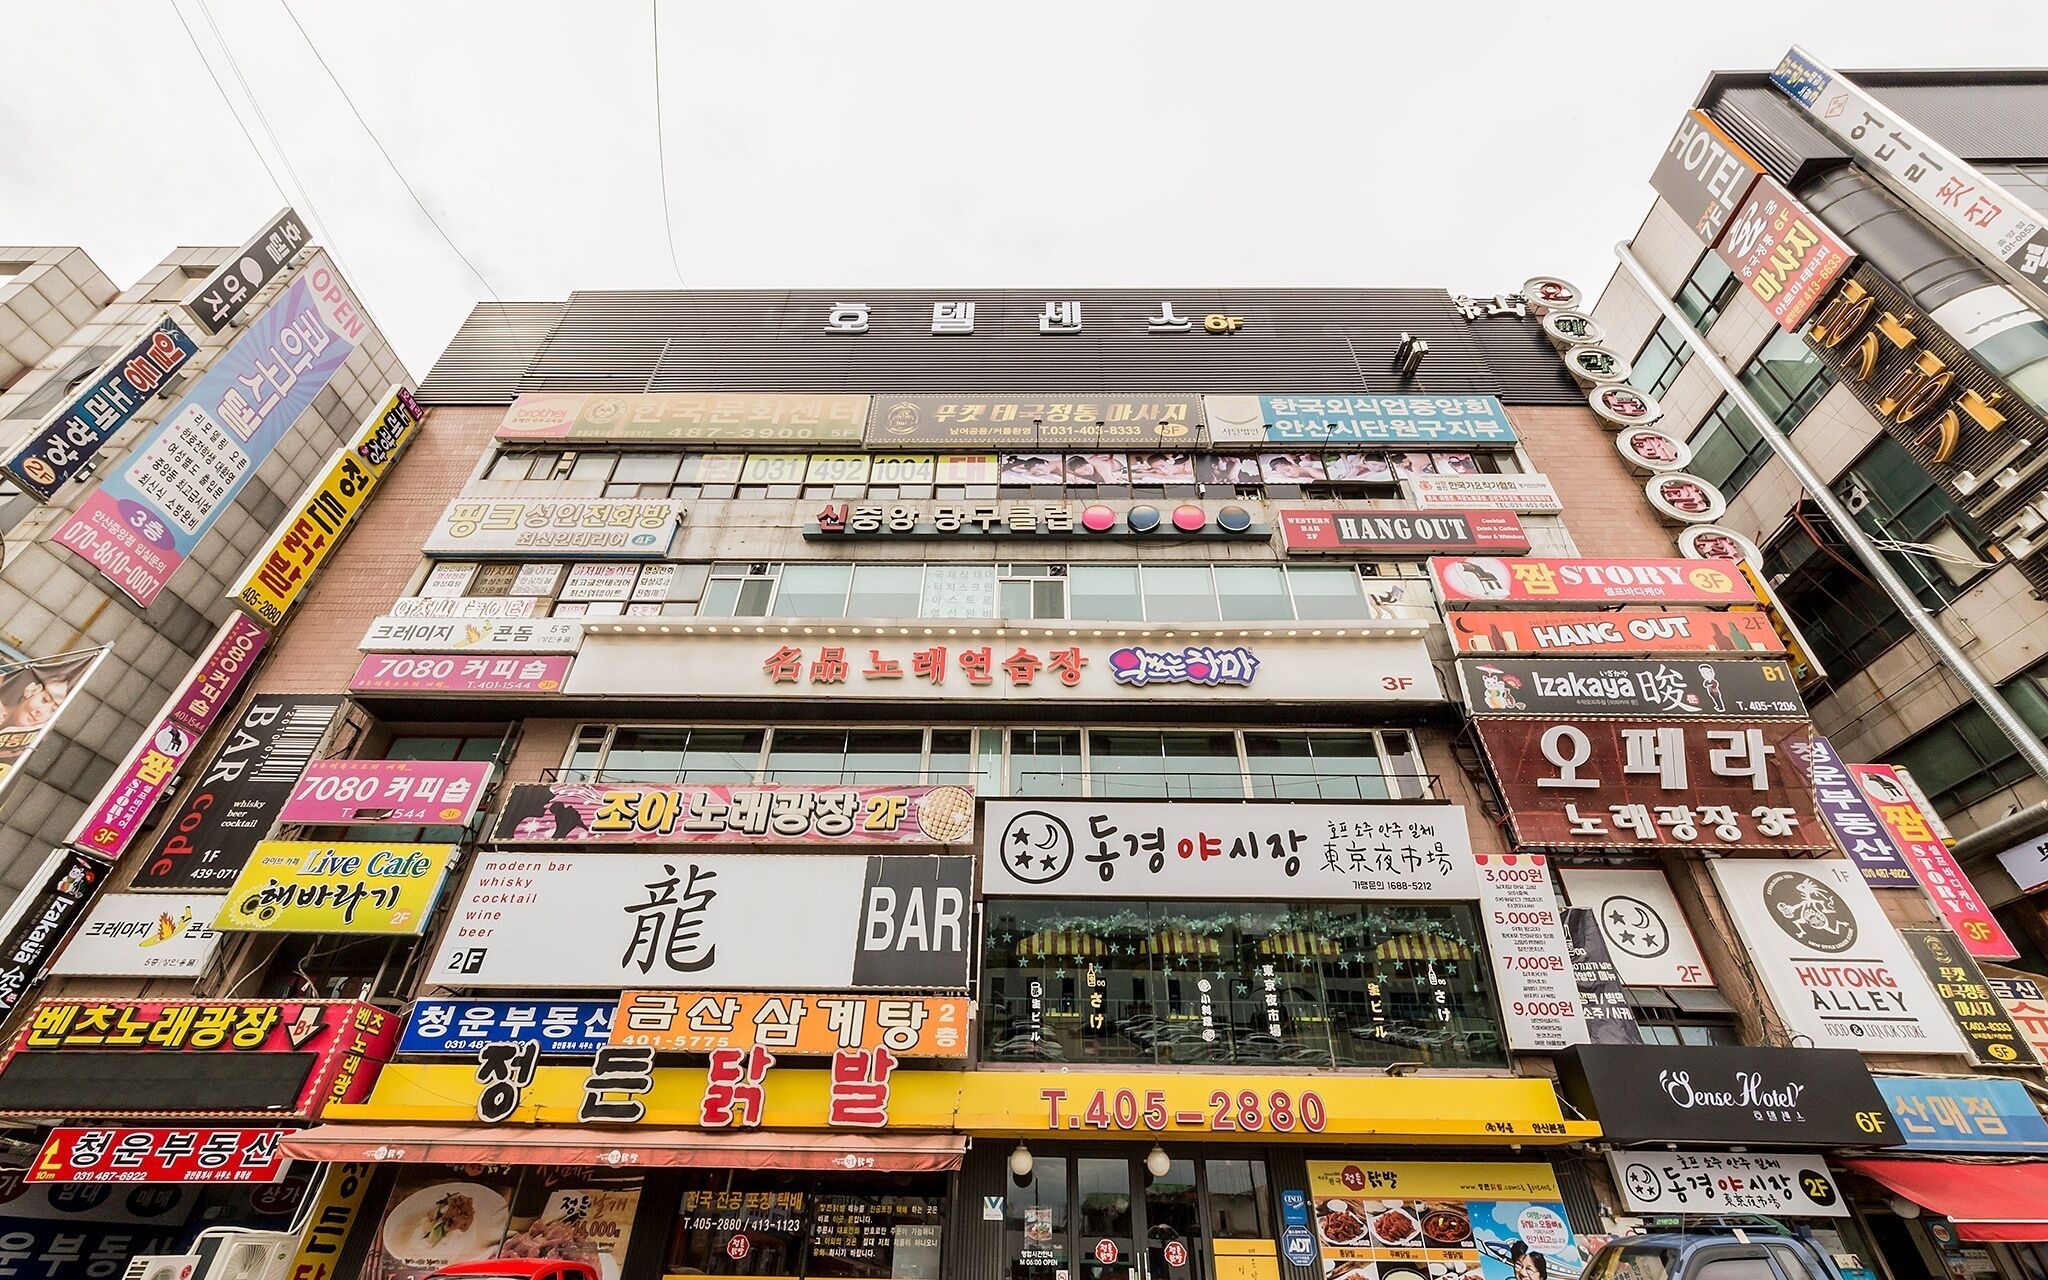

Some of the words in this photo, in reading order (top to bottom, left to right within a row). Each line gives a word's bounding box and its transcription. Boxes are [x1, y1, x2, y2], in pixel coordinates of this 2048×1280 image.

[1670, 116, 1745, 210] HOTEL
[1701, 205, 1723, 240] 7F
[1774, 207, 1790, 232] 6F
[266, 219, 302, 266] 호텔
[2001, 222, 2036, 256] 401-0053
[1752, 224, 1822, 303] 마사지
[1802, 253, 1842, 303] 413-6633
[203, 273, 250, 322] 야자
[311, 268, 366, 339] OPEN
[1774, 279, 1804, 316] 아로마
[1204, 313, 1244, 335] 6F
[517, 407, 569, 418] brother
[632, 400, 861, 426] 한국문화센터
[933, 403, 987, 423] 푸켓
[989, 403, 1100, 423] 태국정통
[1105, 402, 1188, 422] 마사지
[1270, 396, 1494, 418] 한국외식업중앙회
[193, 413, 229, 450] 리모델링
[228, 449, 248, 471] 오픈
[366, 402, 410, 464] 노래광장
[666, 426, 814, 440] 487-3900
[23, 456, 57, 486] 2F
[151, 456, 178, 482] 중앙동
[752, 457, 798, 482] 031
[813, 457, 863, 481] 492
[875, 458, 932, 481] 1004
[136, 471, 167, 502] 최신식
[199, 472, 226, 501] 출입문
[128, 508, 166, 542] 3층
[448, 502, 525, 538] 핑크
[523, 504, 672, 529] 성인전화방
[1286, 517, 1331, 526] WESTERN
[1300, 525, 1321, 533] BAR
[1340, 516, 1414, 539] HANG
[1412, 517, 1469, 540] OUT
[515, 531, 628, 547] 최신인테리어
[634, 534, 655, 546] 4F
[61, 519, 160, 600] 070-8610-0007
[1511, 563, 1557, 596] 짬
[1559, 564, 1687, 588] STORY
[1696, 571, 1726, 590] 3F
[1603, 585, 1666, 597] 셀프바디케어
[242, 586, 282, 624] 405-2880
[371, 624, 456, 642] 크레이지
[492, 624, 534, 642] 콘돔
[1532, 621, 1625, 648] HANG
[1627, 616, 1691, 641] OUT
[1742, 616, 1766, 630] 2F
[220, 623, 261, 673] 7080
[374, 659, 453, 679] 7080
[460, 660, 548, 680] 커피숍
[763, 645, 850, 684] 名品
[862, 645, 1089, 688] 노래연습장
[188, 670, 230, 718] 커피숍
[467, 680, 532, 691] T.401-1544
[1381, 676, 1414, 691] 3F
[1535, 671, 1637, 700] Izakaya
[1762, 666, 1787, 682] B1
[1749, 701, 1798, 713] 405-1206
[174, 708, 206, 733] 401-1544
[203, 704, 284, 789] BAR
[1537, 724, 1776, 791] 오페라
[135, 748, 176, 786] 짬
[103, 779, 141, 824] STORY
[296, 776, 380, 802] 7080
[383, 776, 473, 804] 커피숍
[226, 808, 248, 818] beer
[232, 798, 267, 810] whisky
[592, 791, 684, 836] 조아
[684, 791, 860, 837] 노래광장
[863, 796, 908, 832] 2F
[150, 793, 214, 877] code
[220, 818, 259, 829] cocktail
[1327, 820, 1348, 840] 호프
[1355, 821, 1373, 839] 소주
[1378, 821, 1403, 839] 안주
[1565, 803, 1743, 843] 노래광장
[1750, 805, 1800, 838] 3F
[1880, 804, 1935, 843] 짬
[93, 828, 120, 845] 3F
[201, 849, 222, 863] 1F
[297, 849, 363, 878] Live
[365, 849, 432, 878] Cafe
[486, 862, 542, 872] modern
[548, 862, 573, 872] bar
[1320, 840, 1454, 877] 東京夜市場
[480, 877, 533, 889] whisky
[1353, 881, 1385, 890] 가맹문의
[1386, 881, 1433, 891] 1688-5212
[1484, 868, 1544, 883] 3,000원
[1831, 868, 1850, 884] 1F
[1910, 843, 1964, 915] STORY
[259, 880, 400, 928] 해바라기
[472, 893, 538, 904] cocktail
[390, 911, 411, 926] 2F
[466, 910, 502, 920] wine
[621, 864, 719, 976] 龍
[863, 886, 964, 953] BAR
[1494, 911, 1555, 926] 5,000원
[13, 895, 75, 963] Izakaya
[85, 921, 154, 939] 크레이지
[458, 927, 494, 937] beer
[1963, 921, 1991, 942] 3F
[447, 948, 488, 974] 2F
[1502, 956, 1565, 971] 7,000원
[1675, 965, 1702, 983] 2F
[1794, 966, 1899, 988] HUTONG
[1938, 966, 1967, 982] 푸켓
[1261, 964, 1282, 1038] 東京夜市場
[1811, 990, 1909, 1013] ALLEY
[1937, 983, 1990, 1000] 태국정통
[1089, 992, 1105, 1030] さけ
[1367, 982, 1389, 1039] 生ビール
[1434, 990, 1451, 1022] さけ
[1513, 1001, 1576, 1018] 9,000원
[1953, 1001, 1996, 1017] 마사지
[25, 1004, 279, 1049] 벤츠노래광장
[293, 1018, 312, 1038] B1
[627, 996, 931, 1050] 금산삼계탕
[1825, 1023, 1850, 1037] FOOD
[1863, 1025, 1899, 1038] LIQUOR
[1899, 1026, 1928, 1039] STORE
[1960, 1021, 2012, 1033] T.403-8333
[622, 1034, 731, 1049] 401-5775
[1736, 1071, 1806, 1109] Hotel
[1039, 1086, 1328, 1133] T.405-2880
[1854, 1110, 1886, 1134] 6F
[1531, 1122, 1567, 1134] 안산본점
[69, 1130, 284, 1169] 청운부동산
[35, 1171, 56, 1182] 10m
[94, 1171, 148, 1182] 487-6922
[1803, 1176, 1830, 1199] 2F
[686, 1191, 714, 1210] 전국
[716, 1191, 742, 1210] 진공
[776, 1191, 804, 1211] 택배
[1723, 1194, 1783, 1212] 東京夜市場
[683, 1217, 742, 1232] T.405-2880
[751, 1218, 801, 1232] 413-1123
[1288, 1239, 1311, 1254] ADT
